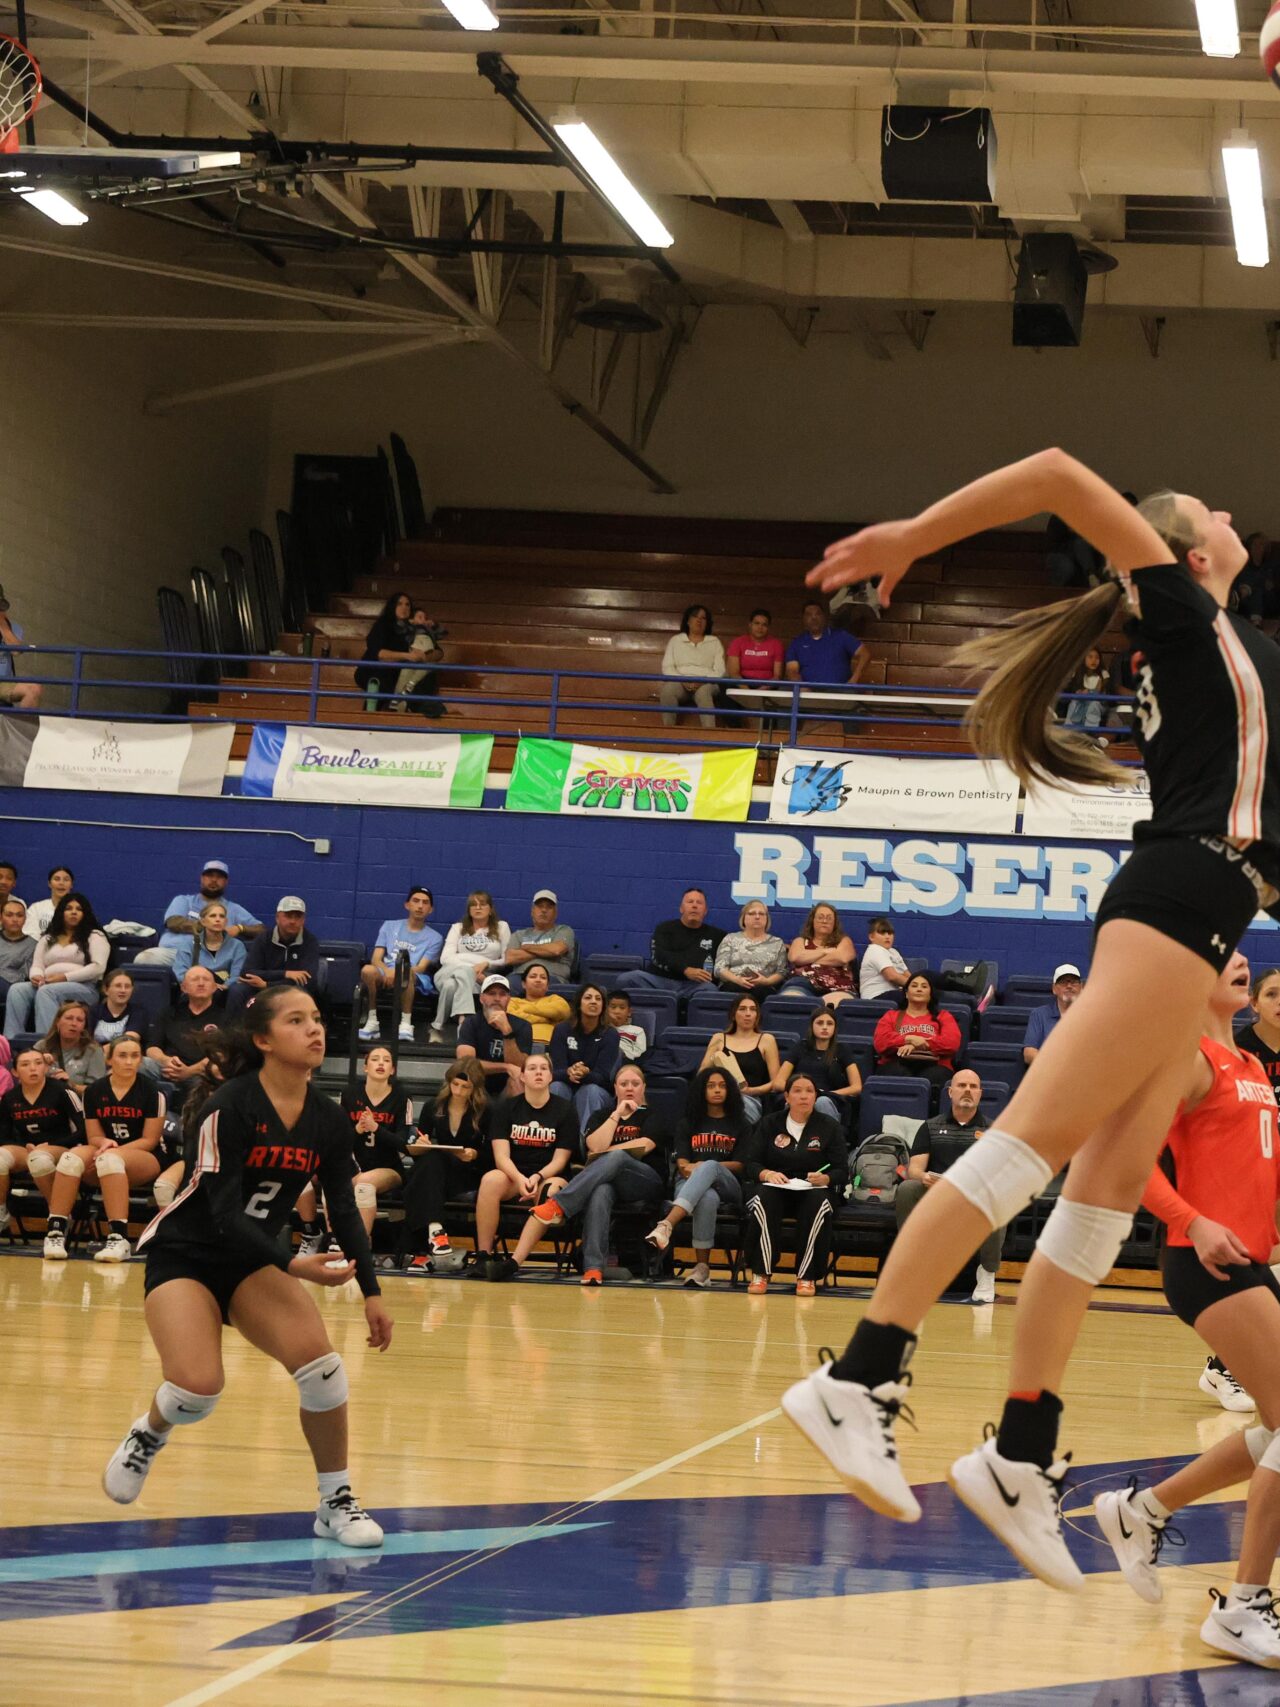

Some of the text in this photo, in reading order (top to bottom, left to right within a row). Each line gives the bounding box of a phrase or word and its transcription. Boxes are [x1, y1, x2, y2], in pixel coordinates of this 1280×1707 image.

[302, 745, 381, 769] Bowles
[585, 769, 681, 792] Graves
[857, 785, 1013, 802] Maupin & Brown Dentistry
[111, 1122, 130, 1139] 16
[365, 1132, 376, 1147] 3
[510, 1123, 557, 1143] BULLDOG
[1260, 1108, 1273, 1159] 0
[244, 1180, 283, 1219] 2
